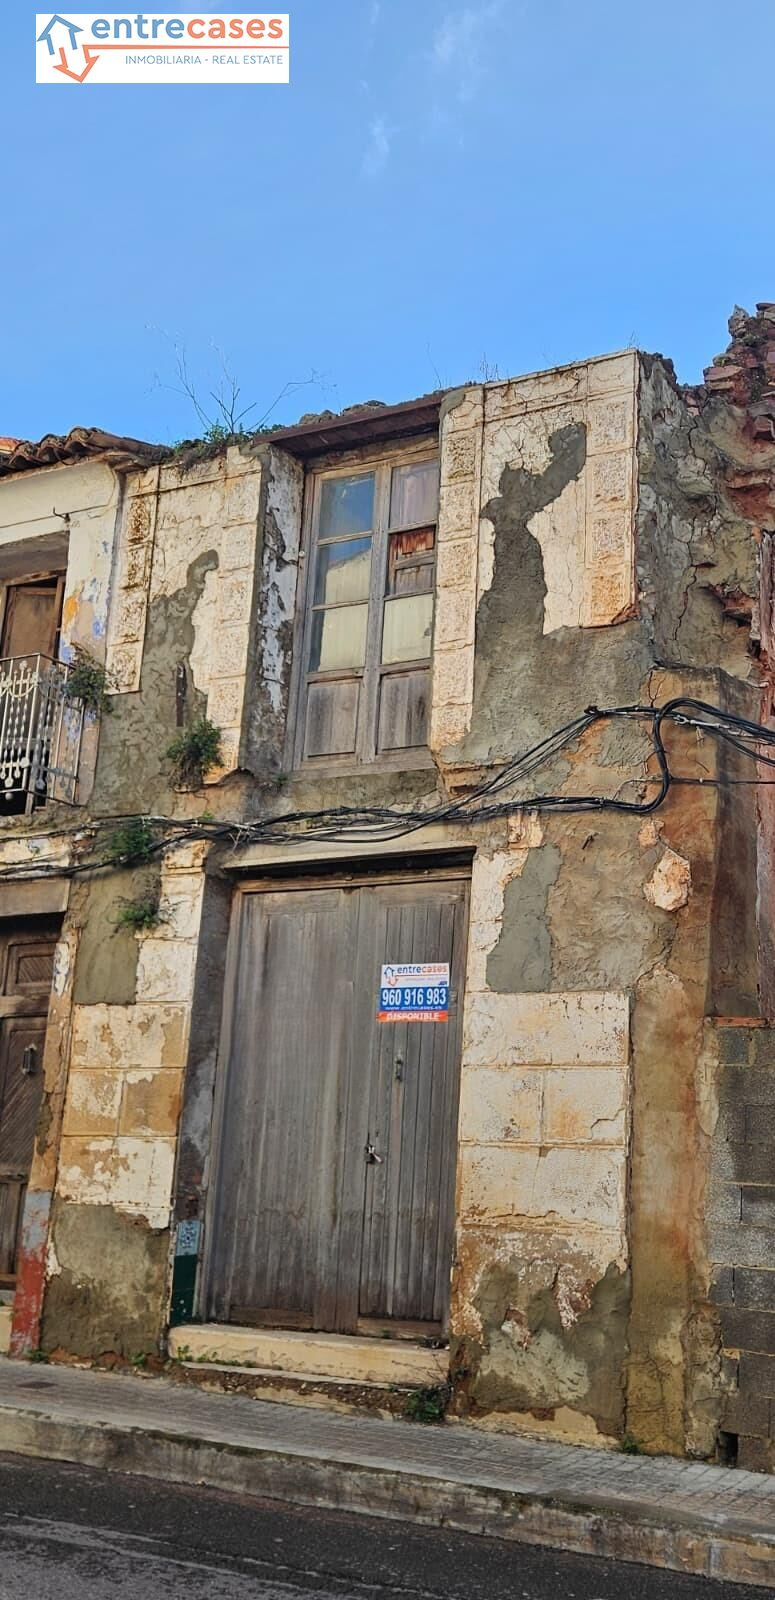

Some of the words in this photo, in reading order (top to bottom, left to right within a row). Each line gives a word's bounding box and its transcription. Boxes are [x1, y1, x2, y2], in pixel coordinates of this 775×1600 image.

[397, 965, 447, 974] entrecases
[382, 989, 402, 1006] 960
[404, 988, 424, 1005] 916
[426, 987, 446, 1005] 983
[386, 1012, 440, 1020] DISPONIBLE
